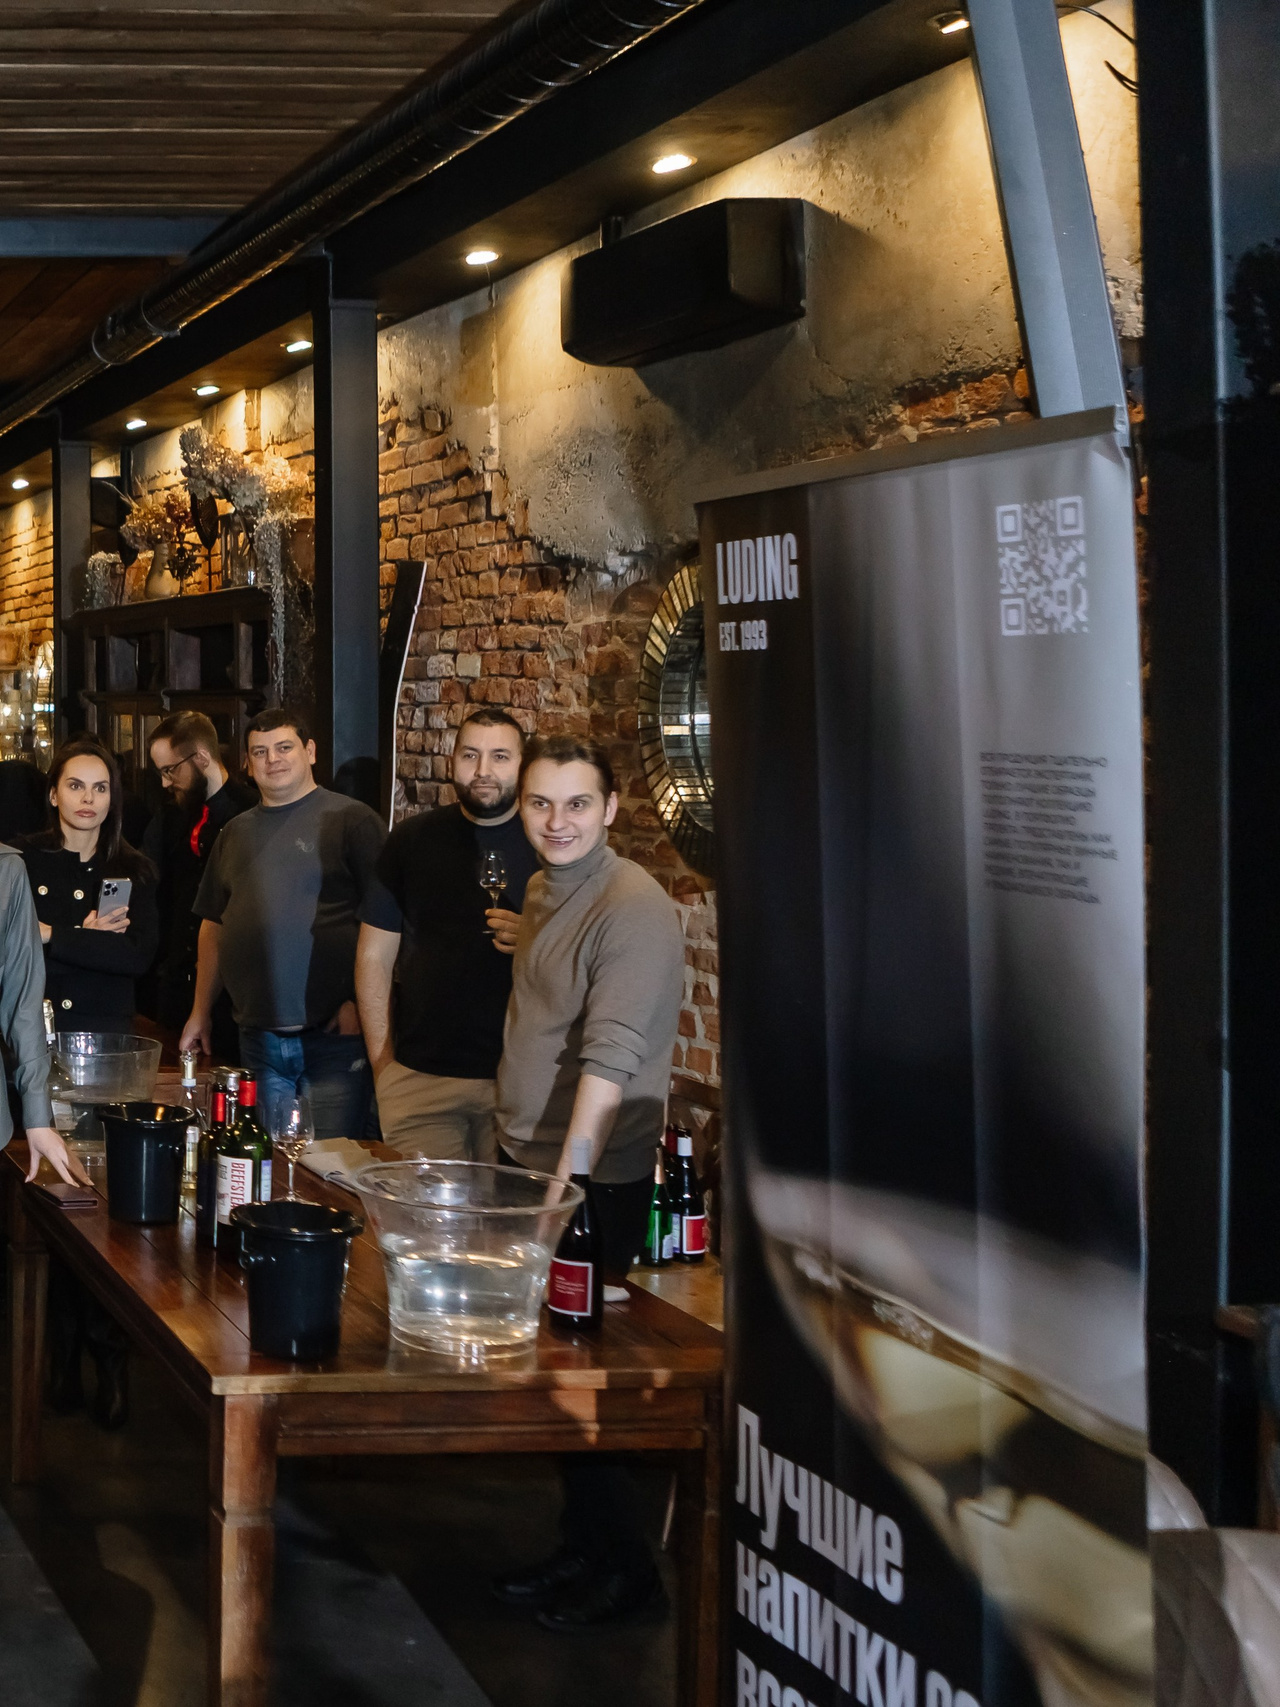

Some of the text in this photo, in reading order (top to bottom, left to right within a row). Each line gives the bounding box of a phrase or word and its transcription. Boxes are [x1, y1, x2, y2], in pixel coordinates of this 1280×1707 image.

[716, 533, 799, 605] LUDING
[719, 620, 768, 651] EST. 1993
[735, 1403, 904, 1604] Лучшие
[736, 1540, 917, 1707] напитки
